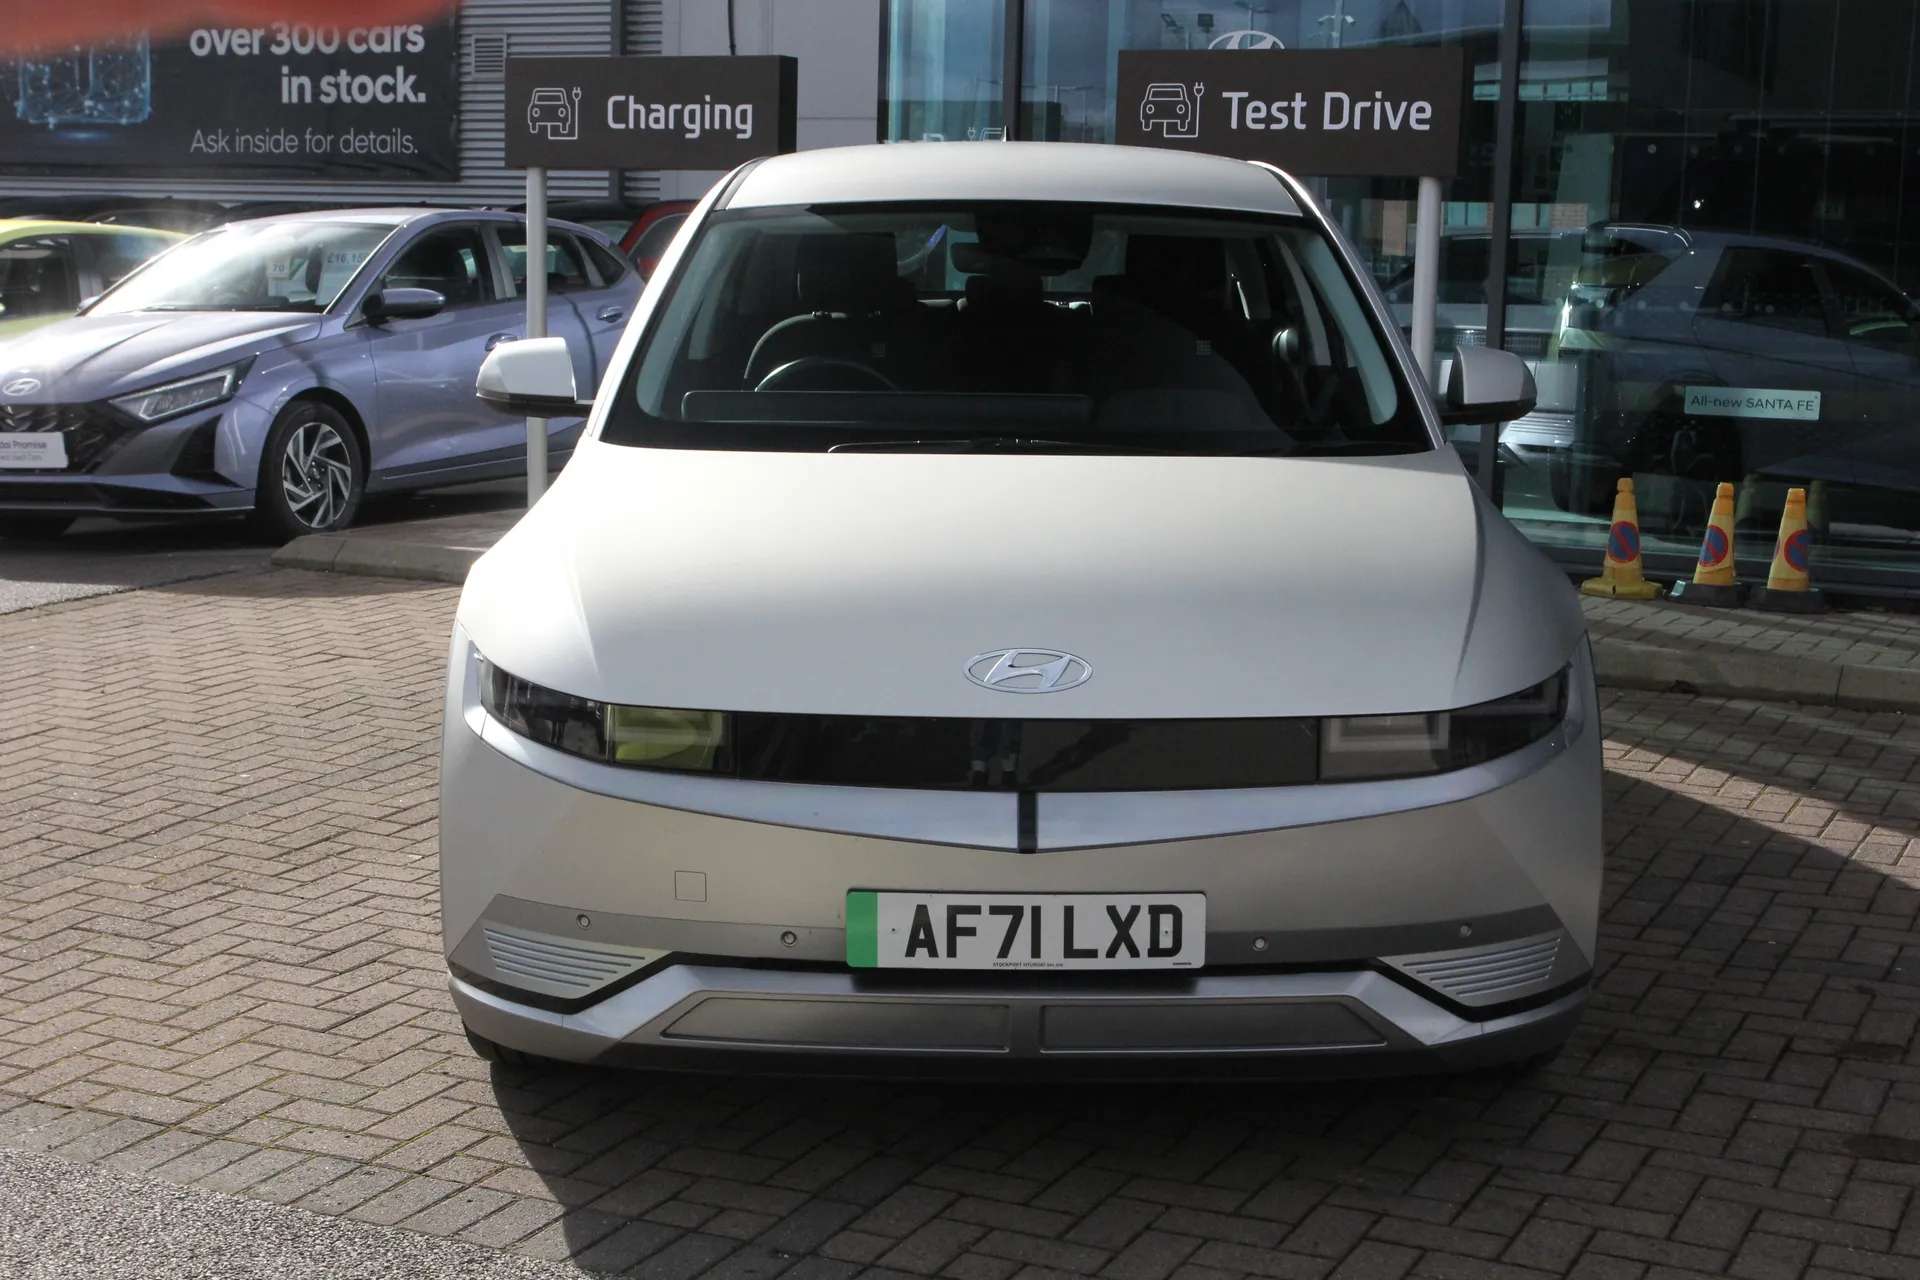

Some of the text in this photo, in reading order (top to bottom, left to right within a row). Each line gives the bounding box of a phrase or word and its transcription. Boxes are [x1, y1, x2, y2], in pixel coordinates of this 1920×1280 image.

[189, 22, 426, 57] over 300 cars
[281, 65, 427, 104] in stock.
[607, 94, 753, 139] Charging
[1222, 90, 1432, 130] Test Drive
[190, 127, 419, 154] Ask inside for details.
[1690, 394, 1815, 411] All-new SANTA FE
[905, 904, 1183, 959] AF71 LXD
